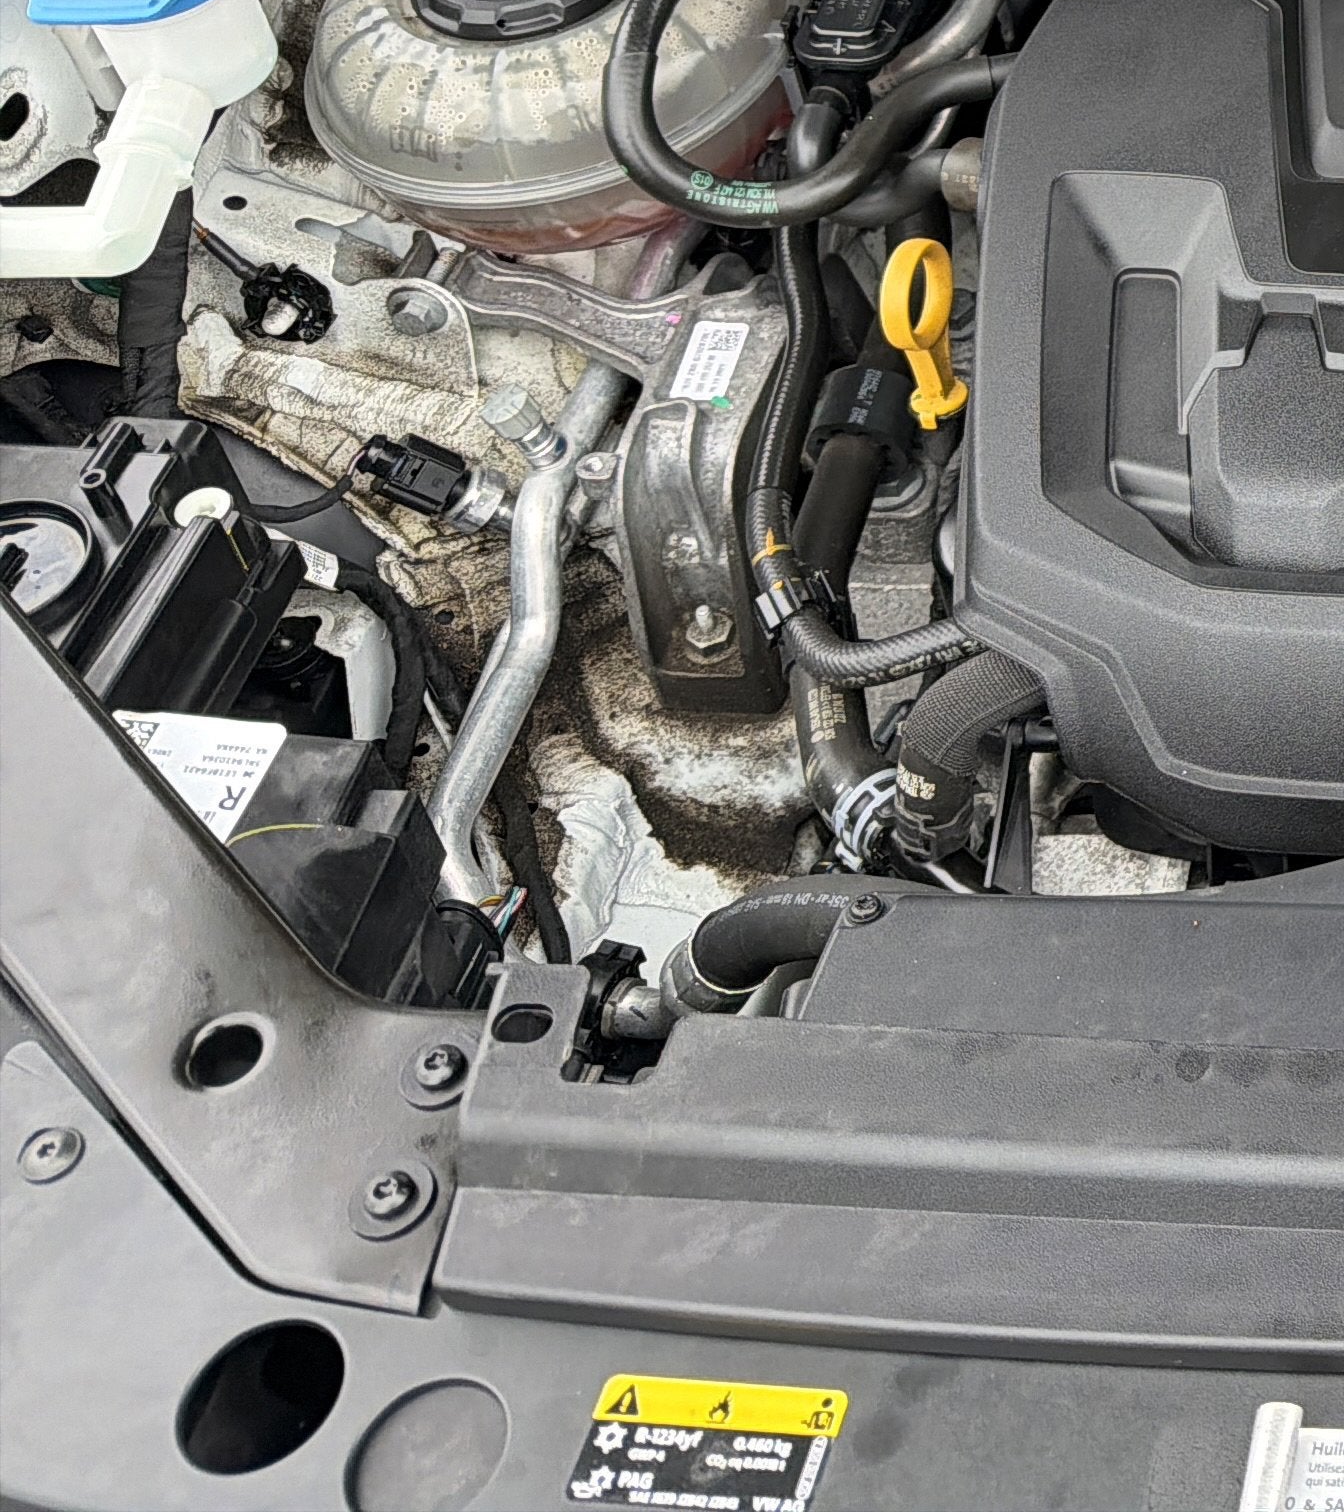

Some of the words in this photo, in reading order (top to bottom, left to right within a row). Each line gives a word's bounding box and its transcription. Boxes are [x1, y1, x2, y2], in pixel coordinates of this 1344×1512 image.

[218, 785, 247, 811] R
[617, 1471, 655, 1490] PAG
[1305, 1477, 1323, 1489] qui
[752, 1496, 779, 1512] VW
